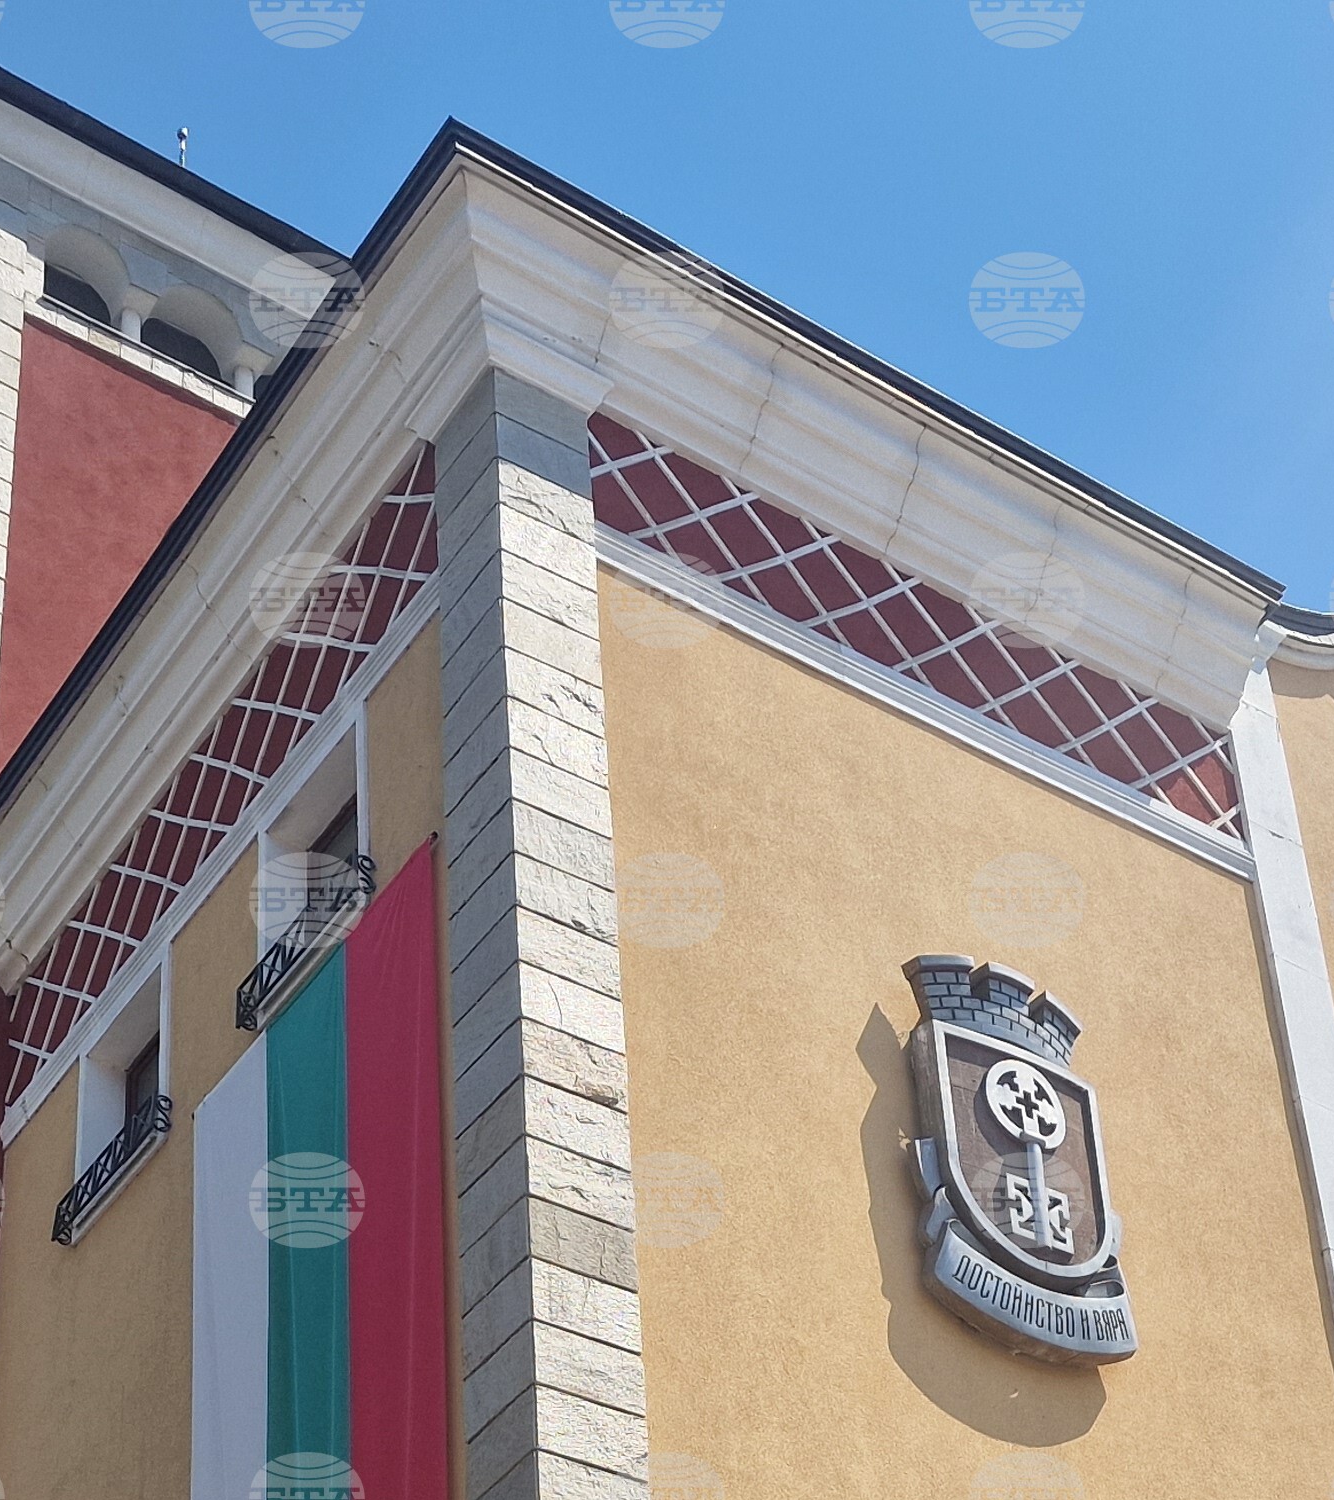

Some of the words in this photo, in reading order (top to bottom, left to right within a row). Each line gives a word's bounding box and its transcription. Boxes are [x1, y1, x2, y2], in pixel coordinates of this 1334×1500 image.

[952, 1254, 1075, 1338] ДОСТОЙНСТВО
[1079, 1308, 1091, 1341] И
[1093, 1307, 1130, 1342] ВЯРА
